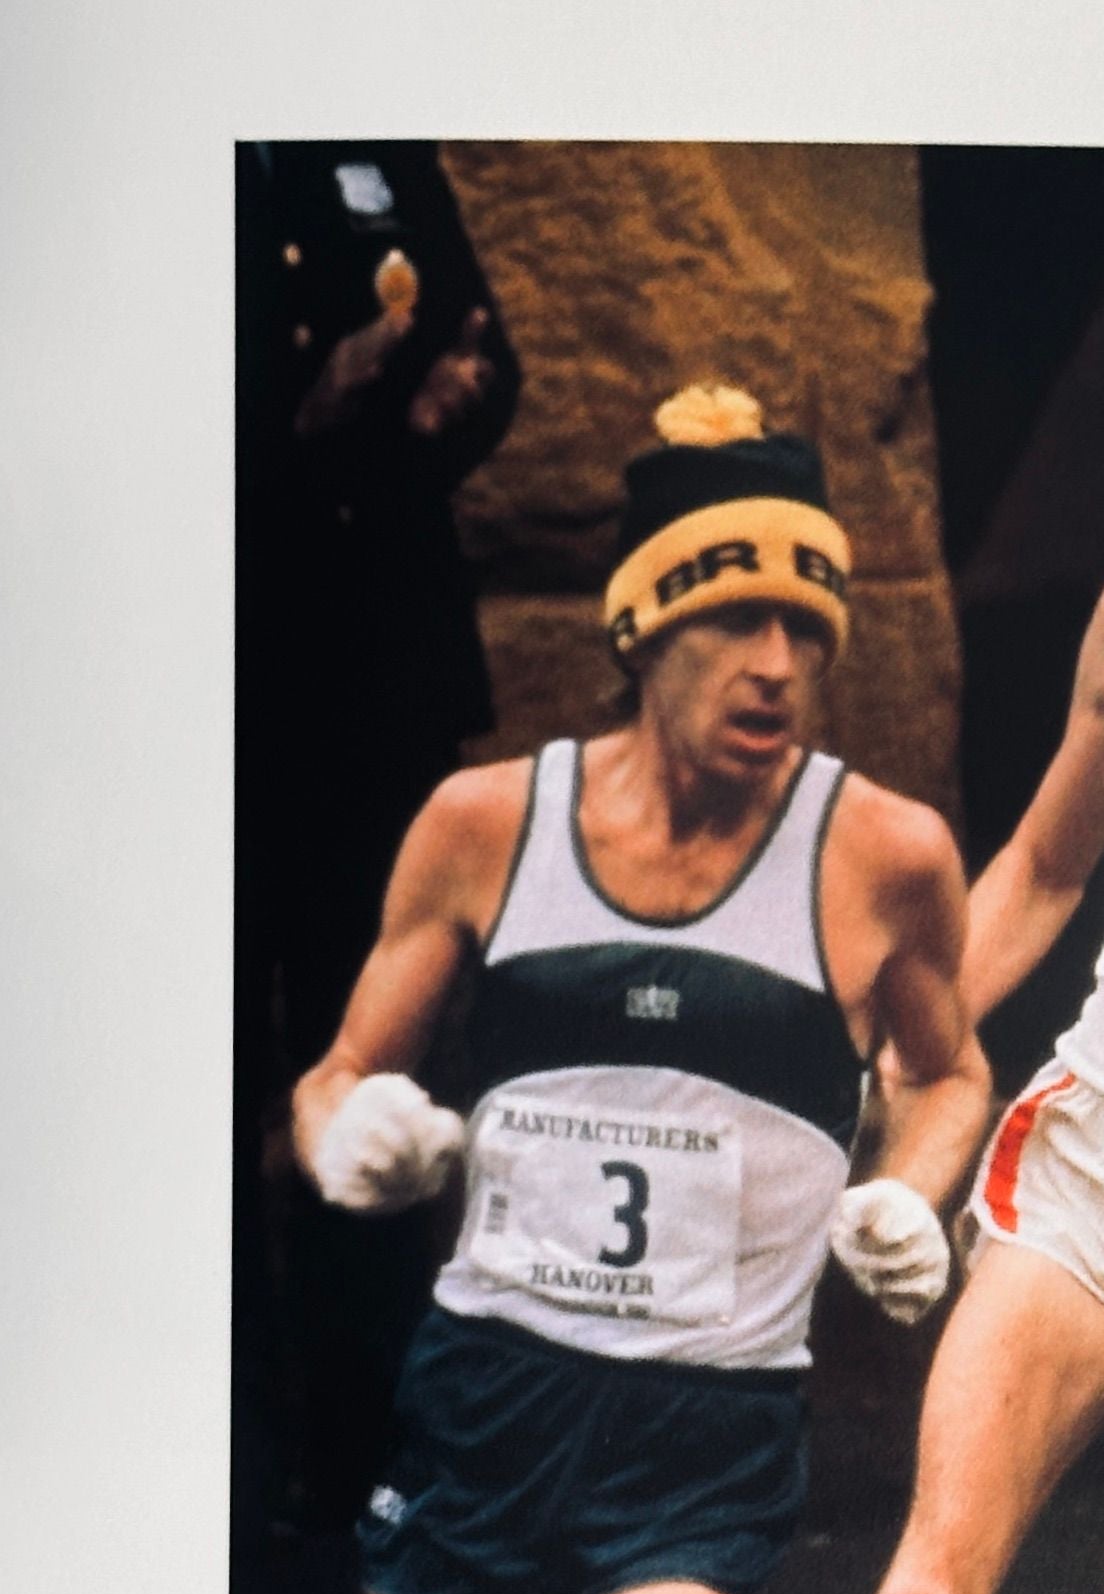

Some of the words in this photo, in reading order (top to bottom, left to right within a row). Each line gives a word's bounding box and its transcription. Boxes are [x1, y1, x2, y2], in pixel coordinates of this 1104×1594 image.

[655, 540, 760, 607] BR
[502, 1109, 720, 1152] MANUFACTURERS
[599, 1159, 650, 1269] 3
[531, 1263, 655, 1296] HANOVER
